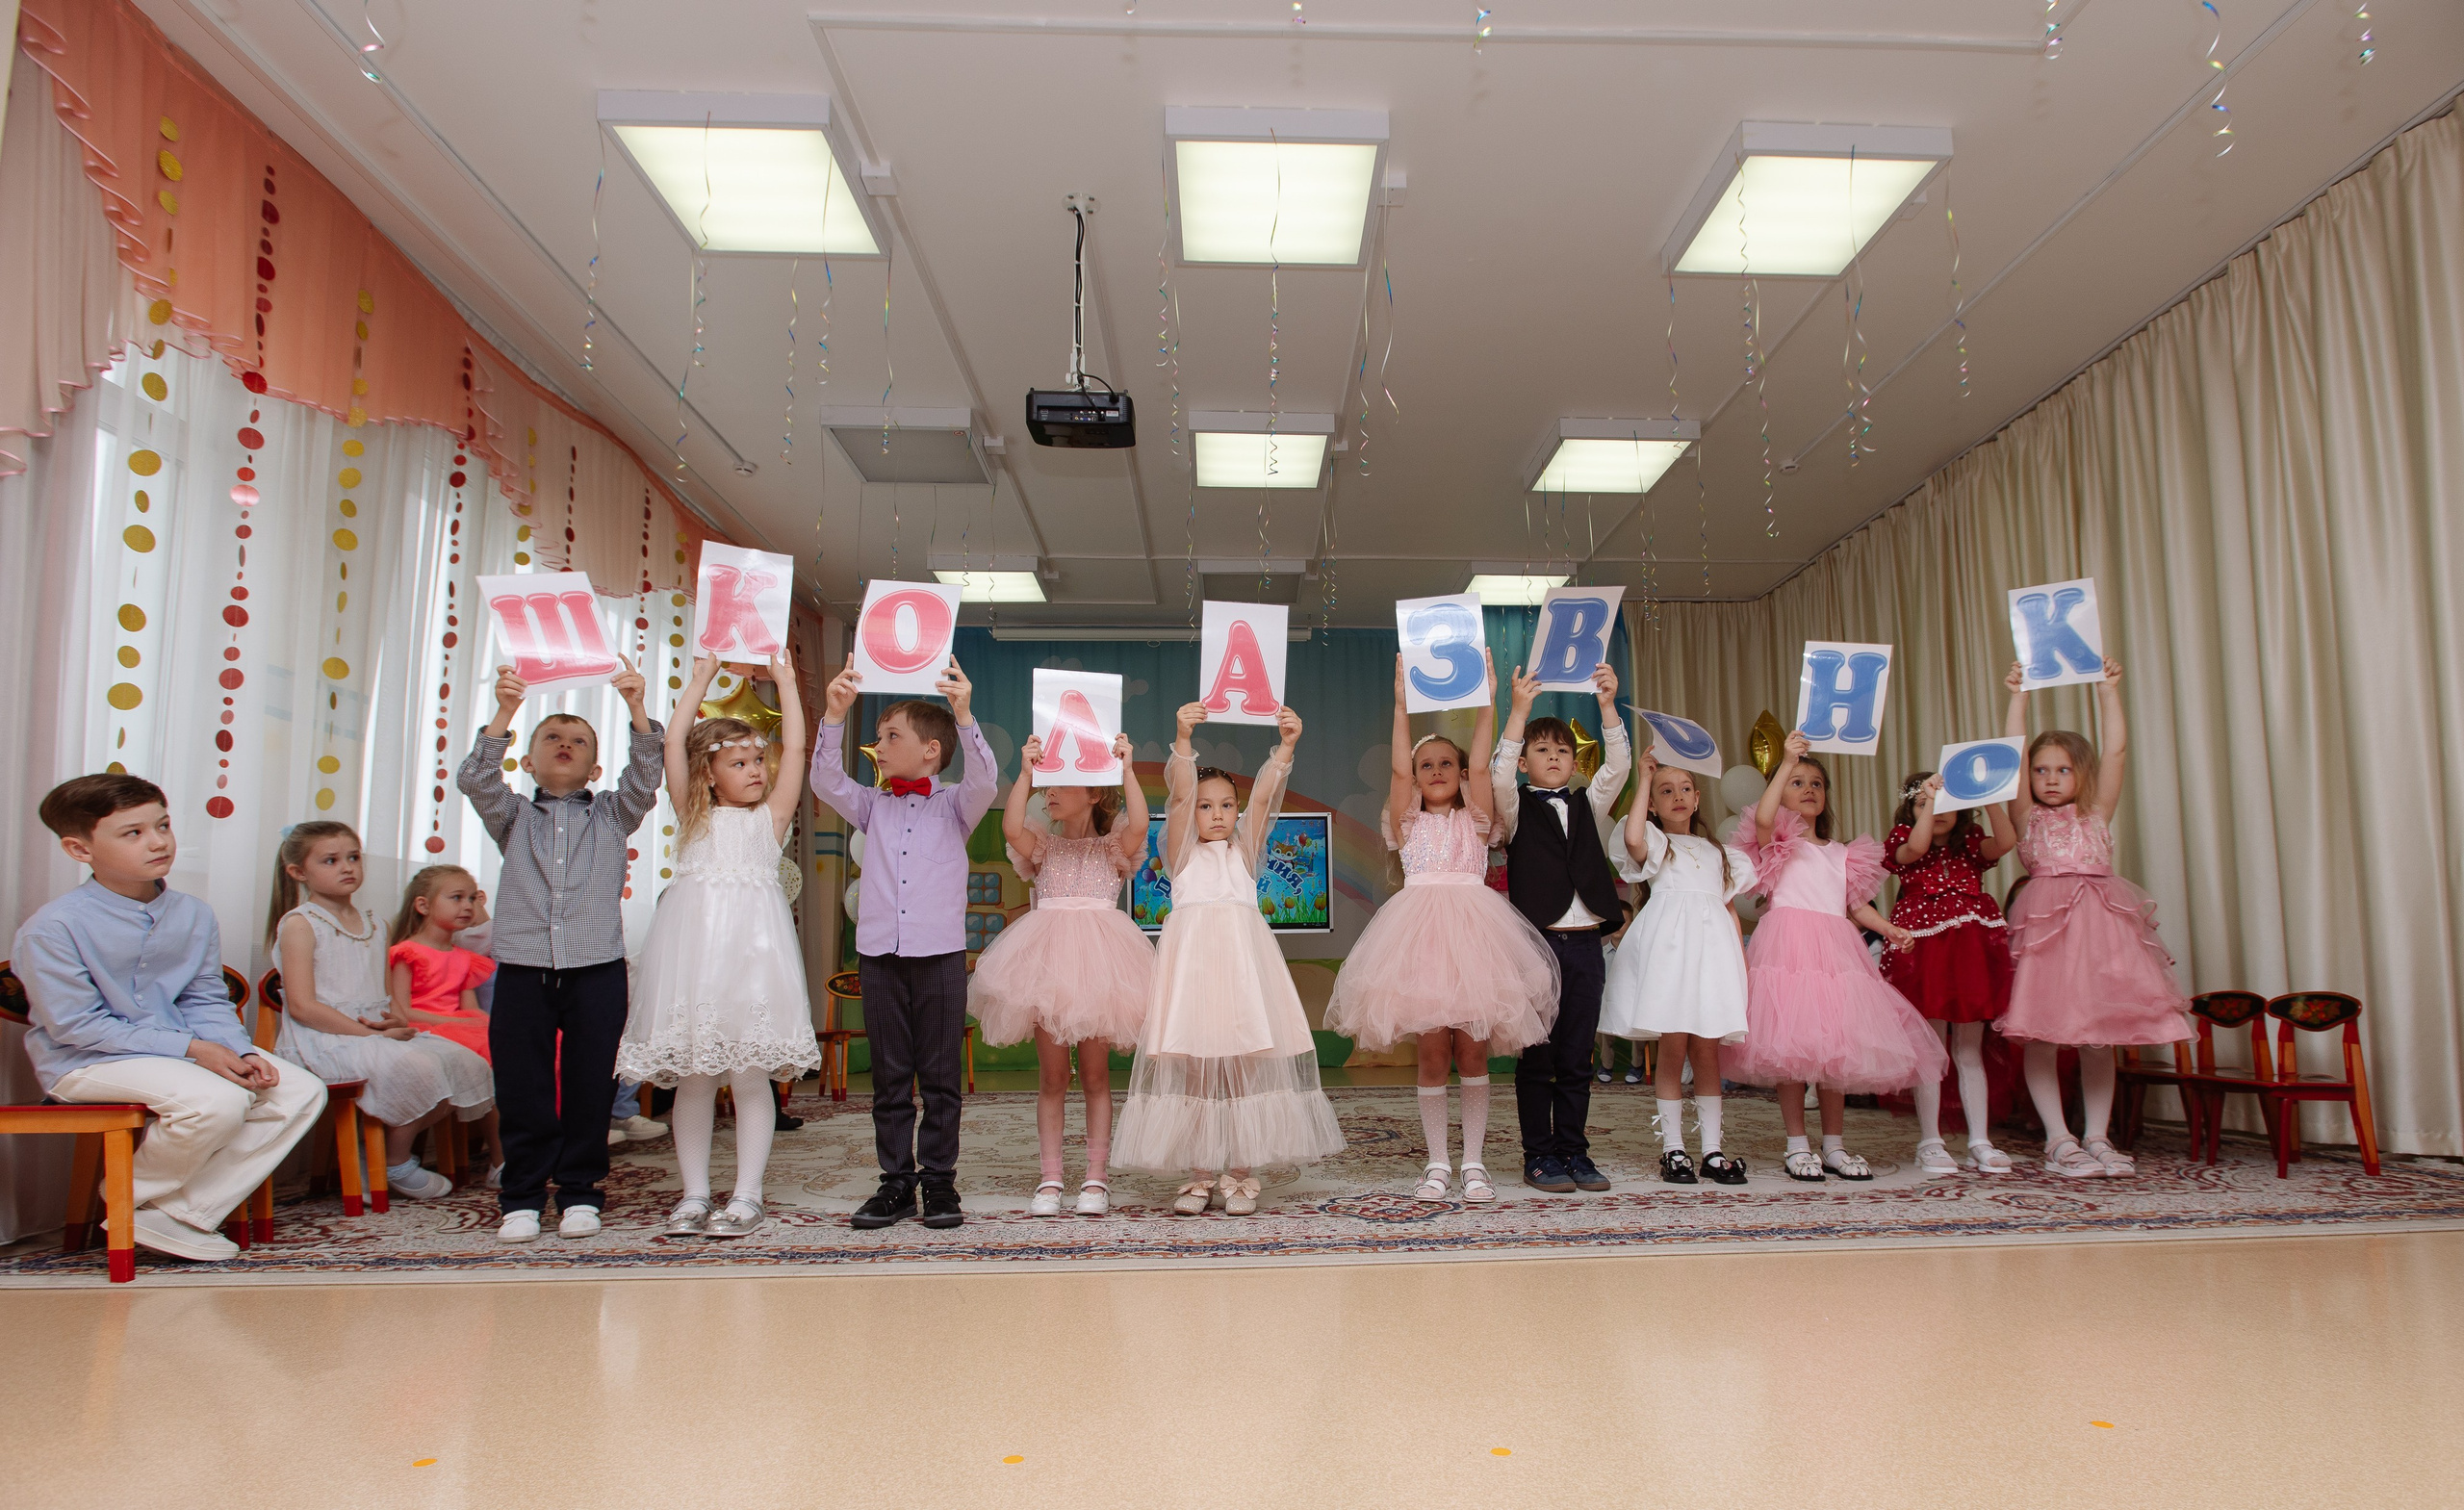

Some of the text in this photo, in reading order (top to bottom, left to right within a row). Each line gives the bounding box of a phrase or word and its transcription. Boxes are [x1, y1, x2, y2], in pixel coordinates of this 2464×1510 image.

[491, 591, 616, 684] Ш
[699, 563, 780, 655] К
[862, 589, 952, 674] О
[1409, 602, 1485, 701] З
[1534, 598, 1608, 683] В
[2016, 587, 2103, 680] К
[1202, 620, 1279, 716] А
[1799, 650, 1887, 743] Н
[1941, 743, 2020, 800] О
